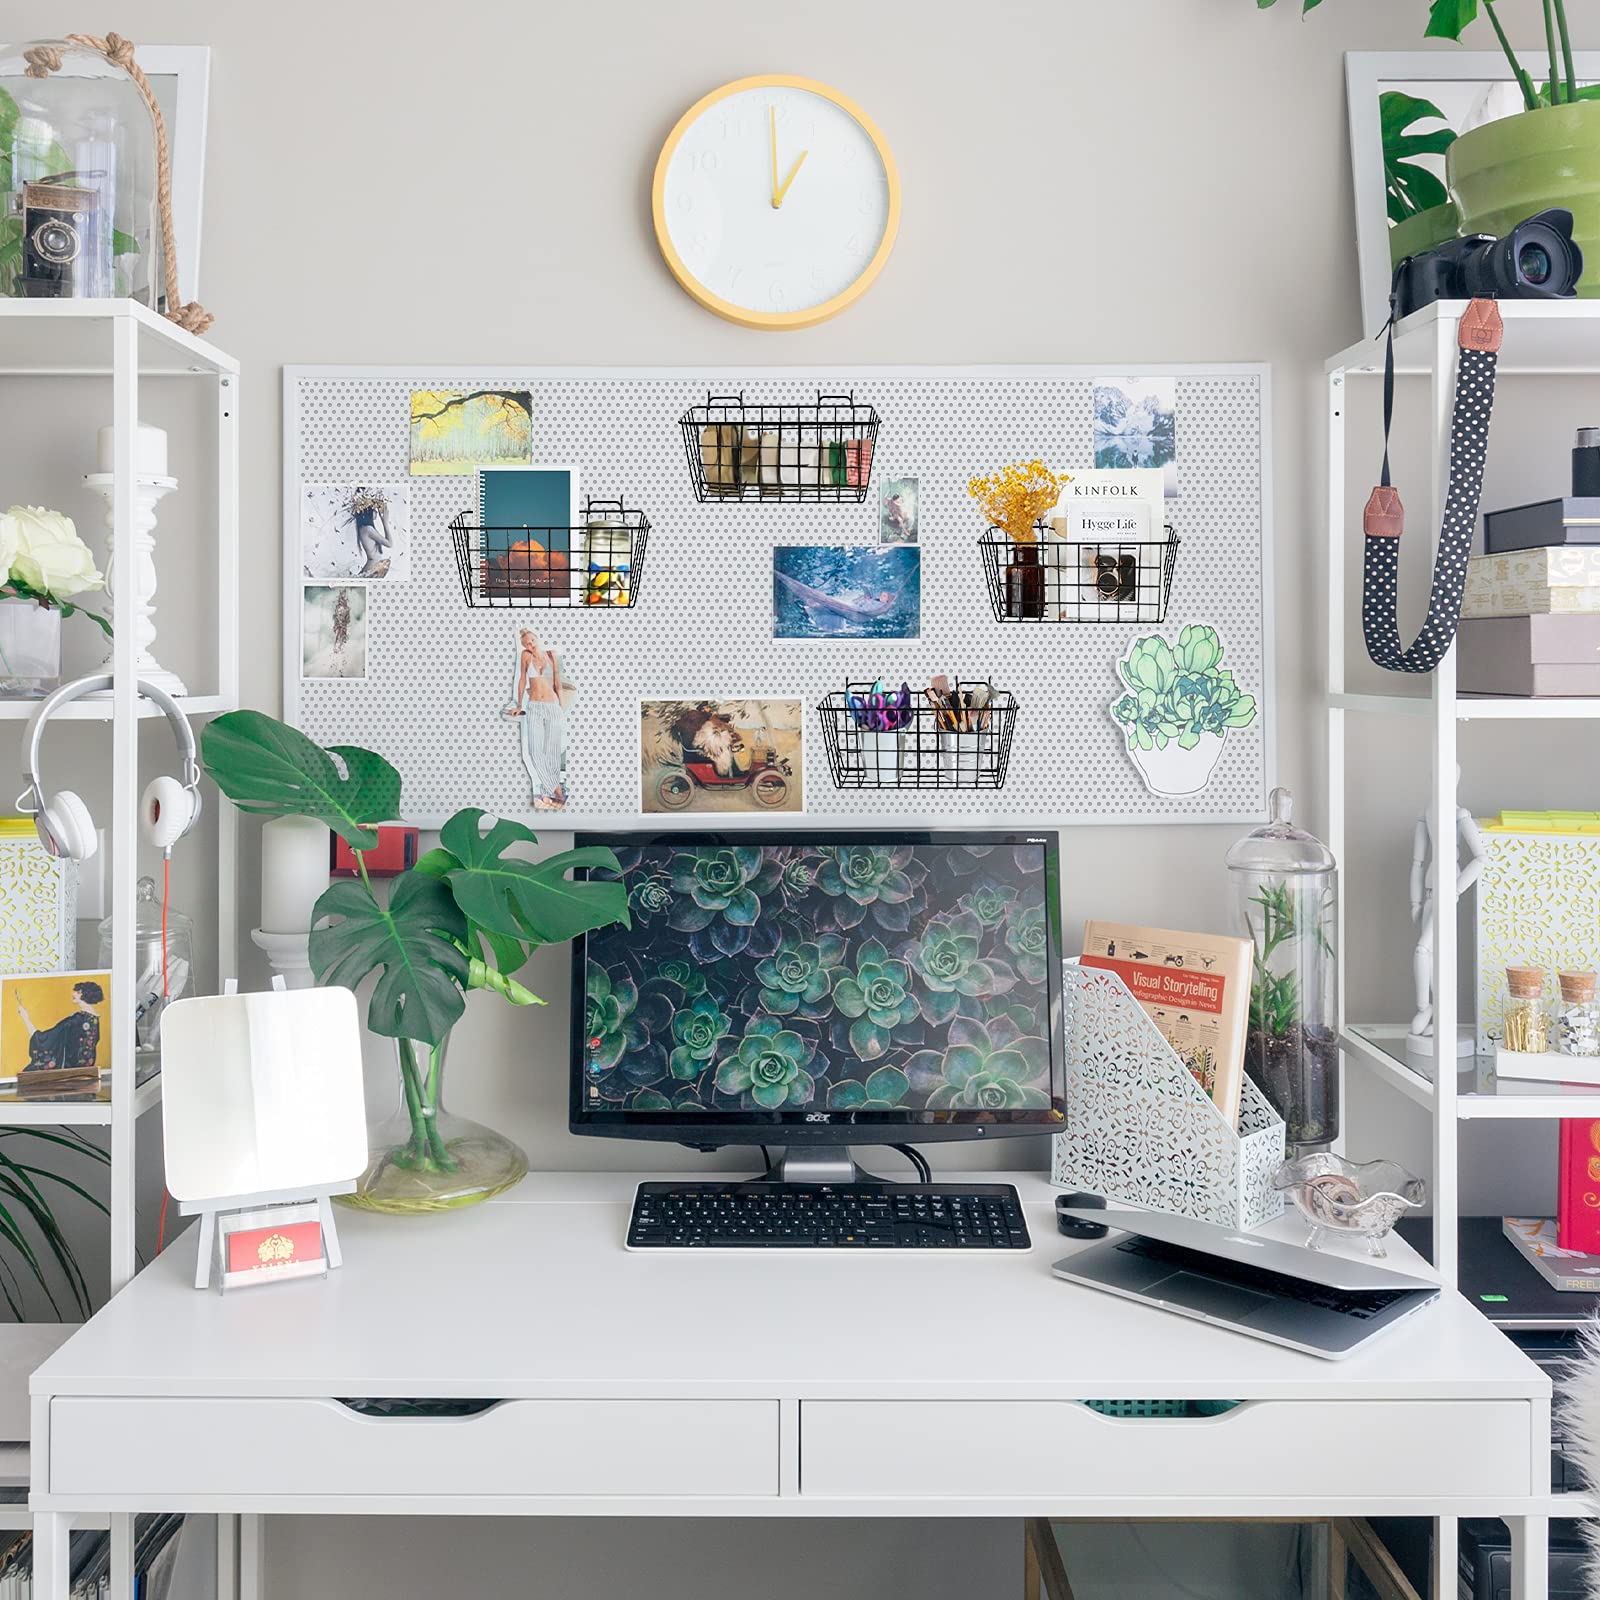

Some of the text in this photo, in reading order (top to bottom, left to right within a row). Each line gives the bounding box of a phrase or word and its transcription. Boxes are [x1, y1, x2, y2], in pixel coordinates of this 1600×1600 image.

[688, 150, 719, 174] 10
[1074, 485, 1138, 496] KINFOLK
[1082, 518, 1137, 531] Hygge Life
[1133, 970, 1161, 989] Visual
[1163, 976, 1218, 1002] Storytelling
[1168, 995, 1190, 1006] Design
[1198, 1000, 1217, 1010] News
[805, 1112, 831, 1124] acer
[1566, 1279, 1600, 1289] FREEL
